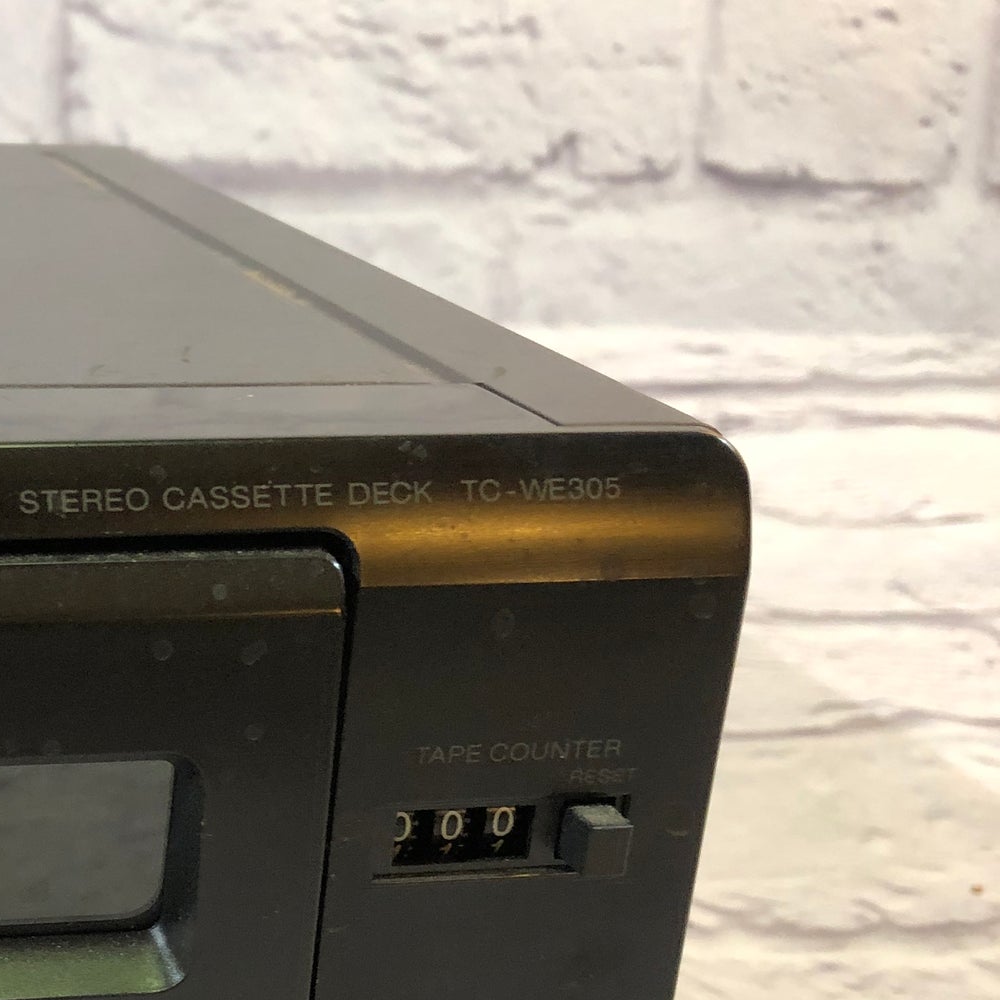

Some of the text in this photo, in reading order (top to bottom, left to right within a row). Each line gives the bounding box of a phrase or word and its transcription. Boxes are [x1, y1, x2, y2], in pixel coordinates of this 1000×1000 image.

[19, 477, 621, 514] STEREO CASSETTE DECK TC-WE305
[417, 738, 622, 765] TAPE COUNTER
[569, 767, 636, 784] RESET
